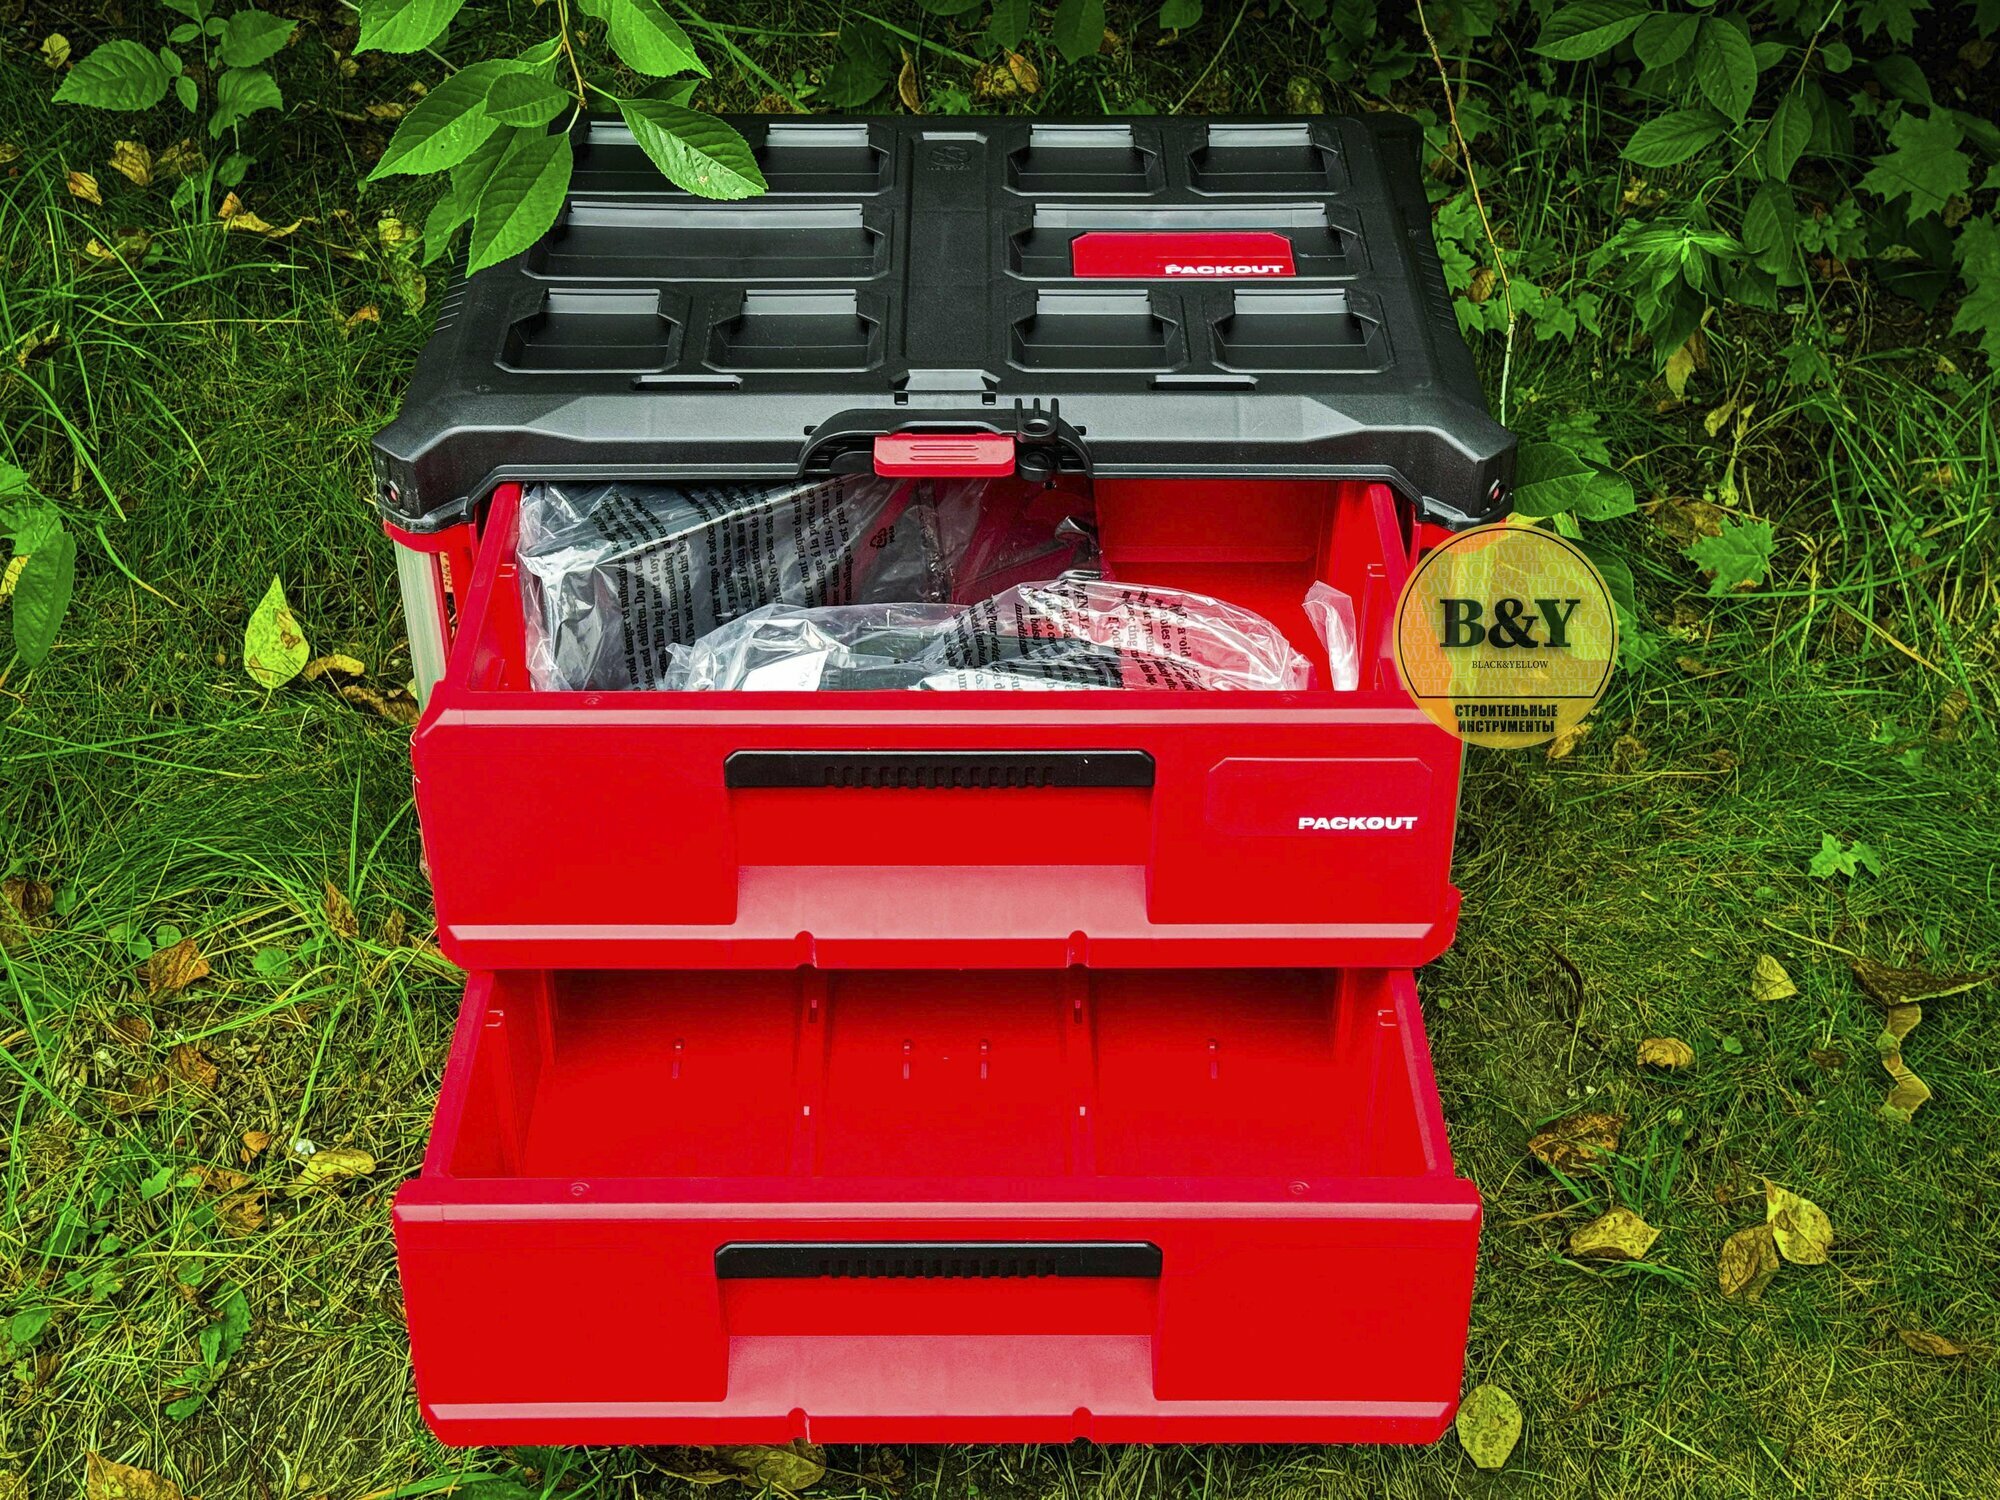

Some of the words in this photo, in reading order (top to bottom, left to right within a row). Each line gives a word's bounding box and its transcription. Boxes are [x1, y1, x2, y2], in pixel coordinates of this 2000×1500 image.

[1165, 264, 1284, 274] PACKOUT
[750, 517, 758, 528] de
[792, 516, 801, 525] de
[836, 507, 848, 525] pas
[794, 526, 806, 560] risque
[810, 538, 819, 550] la
[824, 526, 834, 547] lits,
[634, 555, 642, 571] use
[650, 554, 659, 574] toy.
[678, 555, 689, 573] this
[708, 555, 716, 566] de
[722, 550, 731, 564] No
[828, 548, 837, 563] les
[634, 573, 644, 588] not
[663, 551, 680, 610] immediately
[768, 568, 778, 583] No
[798, 561, 810, 583] tout
[831, 564, 839, 587] dans
[651, 584, 662, 598] not
[682, 575, 692, 606] re-use
[710, 568, 720, 596] riesgo
[741, 576, 750, 599] Esta
[817, 559, 826, 606] mballage
[634, 590, 646, 604] Do
[652, 601, 662, 609] is
[804, 586, 813, 608] viter
[653, 610, 665, 628] bag
[685, 606, 693, 622] not
[637, 605, 651, 645] children.
[685, 624, 694, 638] Do
[624, 622, 635, 655] danger
[655, 629, 666, 650] This
[641, 648, 651, 667] and
[625, 657, 639, 684] avoid
[646, 669, 656, 691] bies
[1298, 816, 1418, 830] PACKOUT
